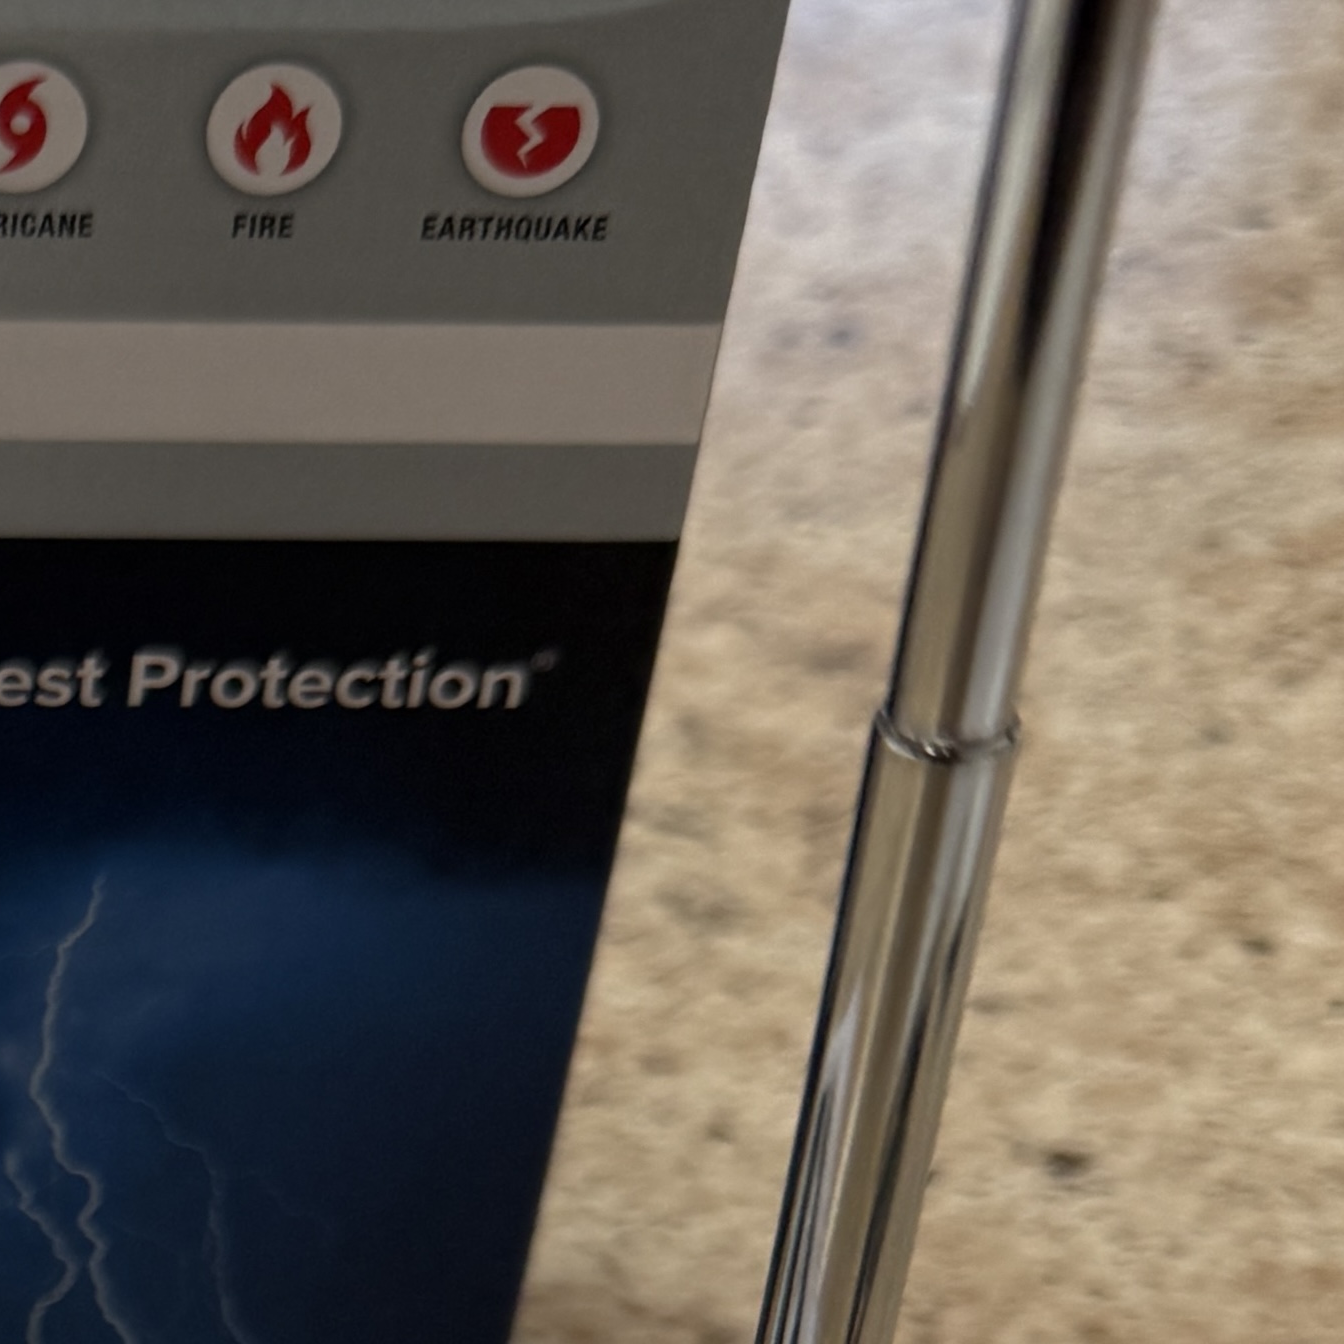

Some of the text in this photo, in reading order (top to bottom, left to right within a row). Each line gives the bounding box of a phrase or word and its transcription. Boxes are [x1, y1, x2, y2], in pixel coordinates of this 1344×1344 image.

[230, 213, 295, 242] FIRE
[420, 214, 611, 244] EARTHQUAKE
[126, 651, 531, 712] Protection
